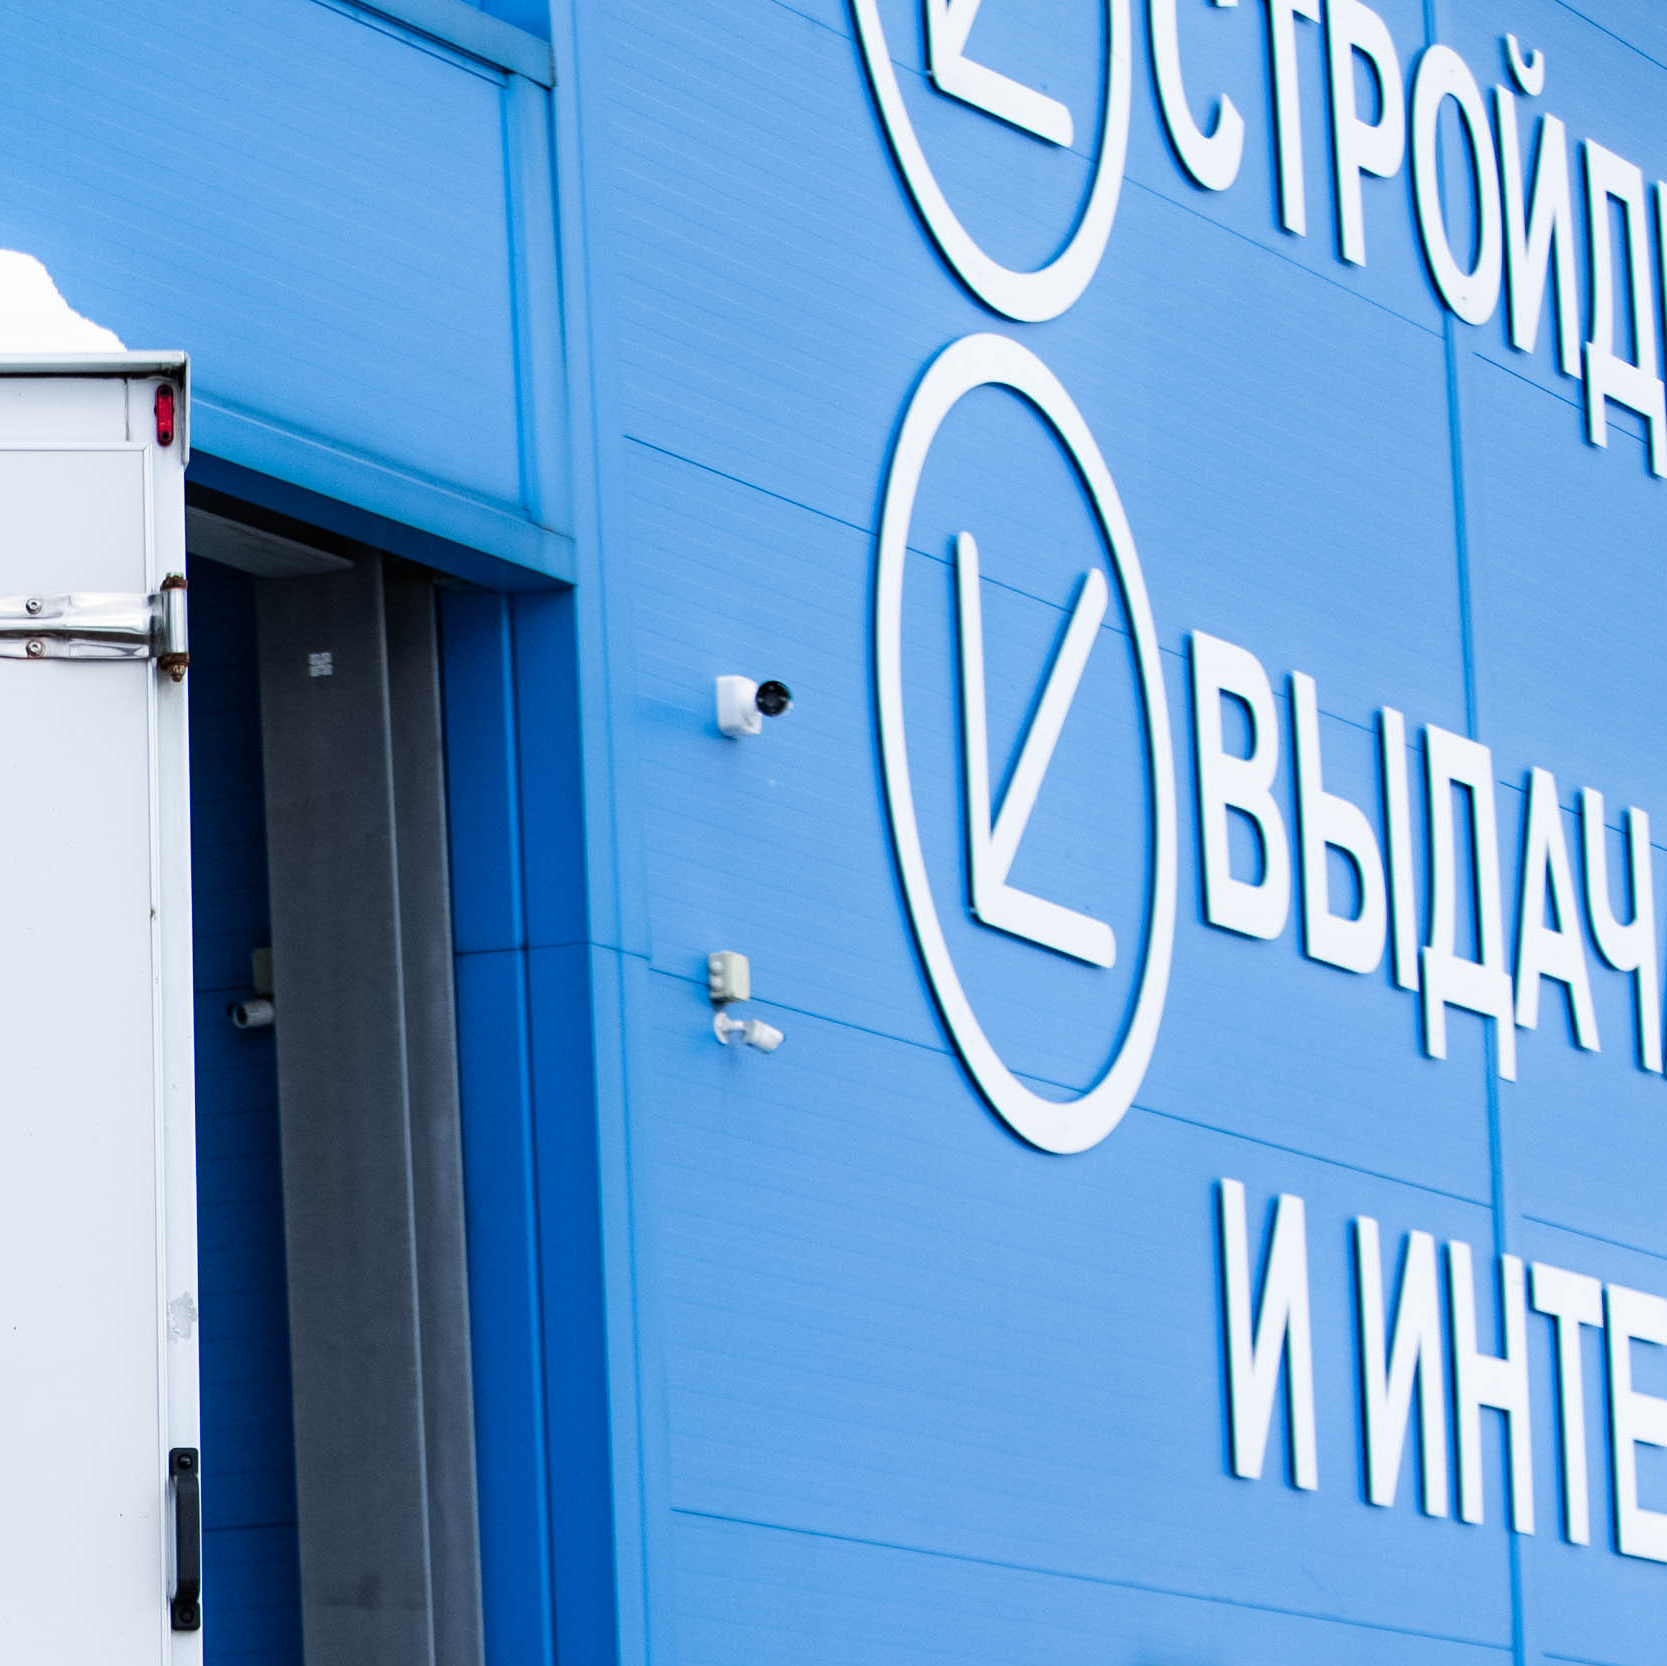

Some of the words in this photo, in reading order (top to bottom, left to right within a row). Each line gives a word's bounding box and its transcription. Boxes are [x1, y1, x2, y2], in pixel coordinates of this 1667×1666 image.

[1151, 0, 1667, 479] СТРОЙД
[1221, 1178, 1318, 1491] И
[1356, 1215, 1667, 1563] ИНТЕ
